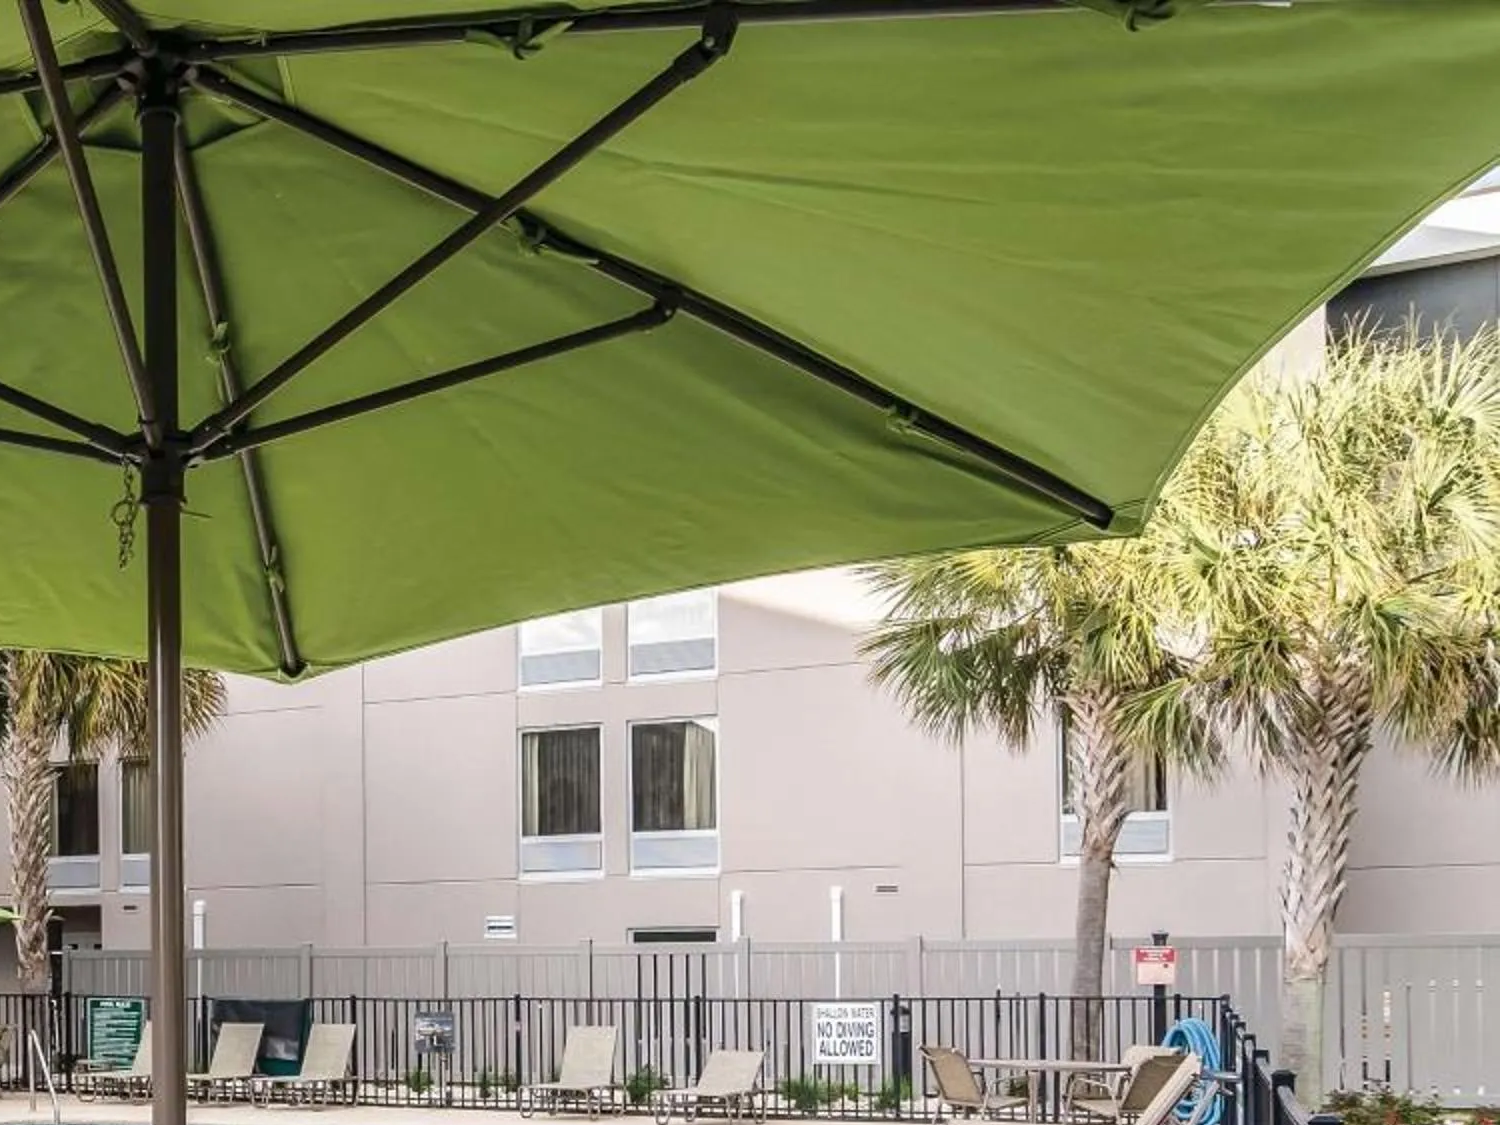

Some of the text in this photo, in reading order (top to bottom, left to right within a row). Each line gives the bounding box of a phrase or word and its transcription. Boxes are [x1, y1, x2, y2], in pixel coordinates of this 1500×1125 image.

[851, 1007, 874, 1018] WATER
[817, 1021, 874, 1038] NO DIVING
[819, 1039, 874, 1056] ALLOWED
